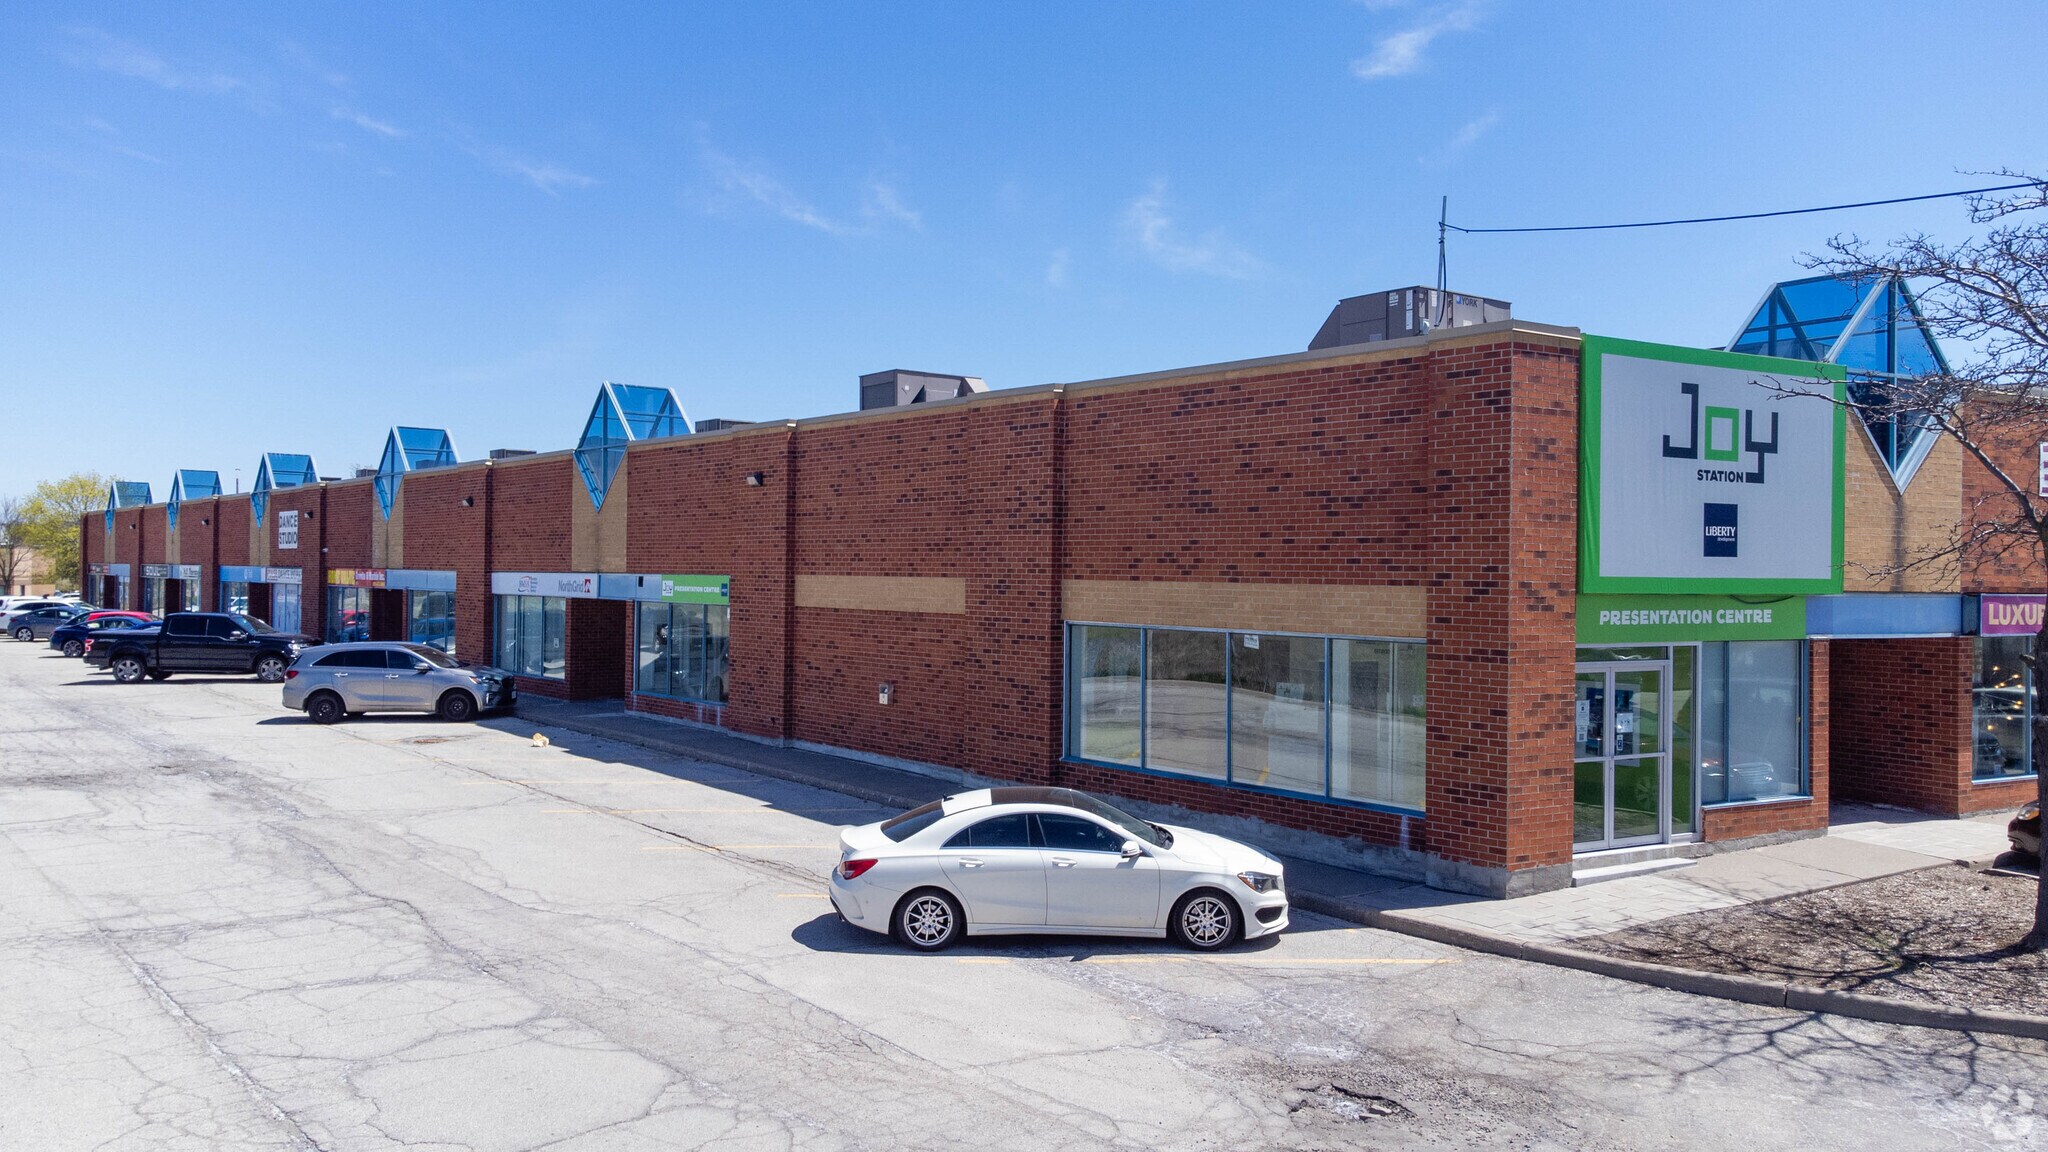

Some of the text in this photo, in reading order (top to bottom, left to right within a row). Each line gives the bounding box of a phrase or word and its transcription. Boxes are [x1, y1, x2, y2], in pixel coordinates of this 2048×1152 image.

[1461, 297, 1478, 308] YORK
[1697, 469, 1744, 483] STATION
[279, 514, 298, 528] DANCE
[279, 531, 298, 545] STUDIO
[558, 579, 584, 593] NorthGrid
[1599, 609, 1772, 626] PRESENTATION CENTRE
